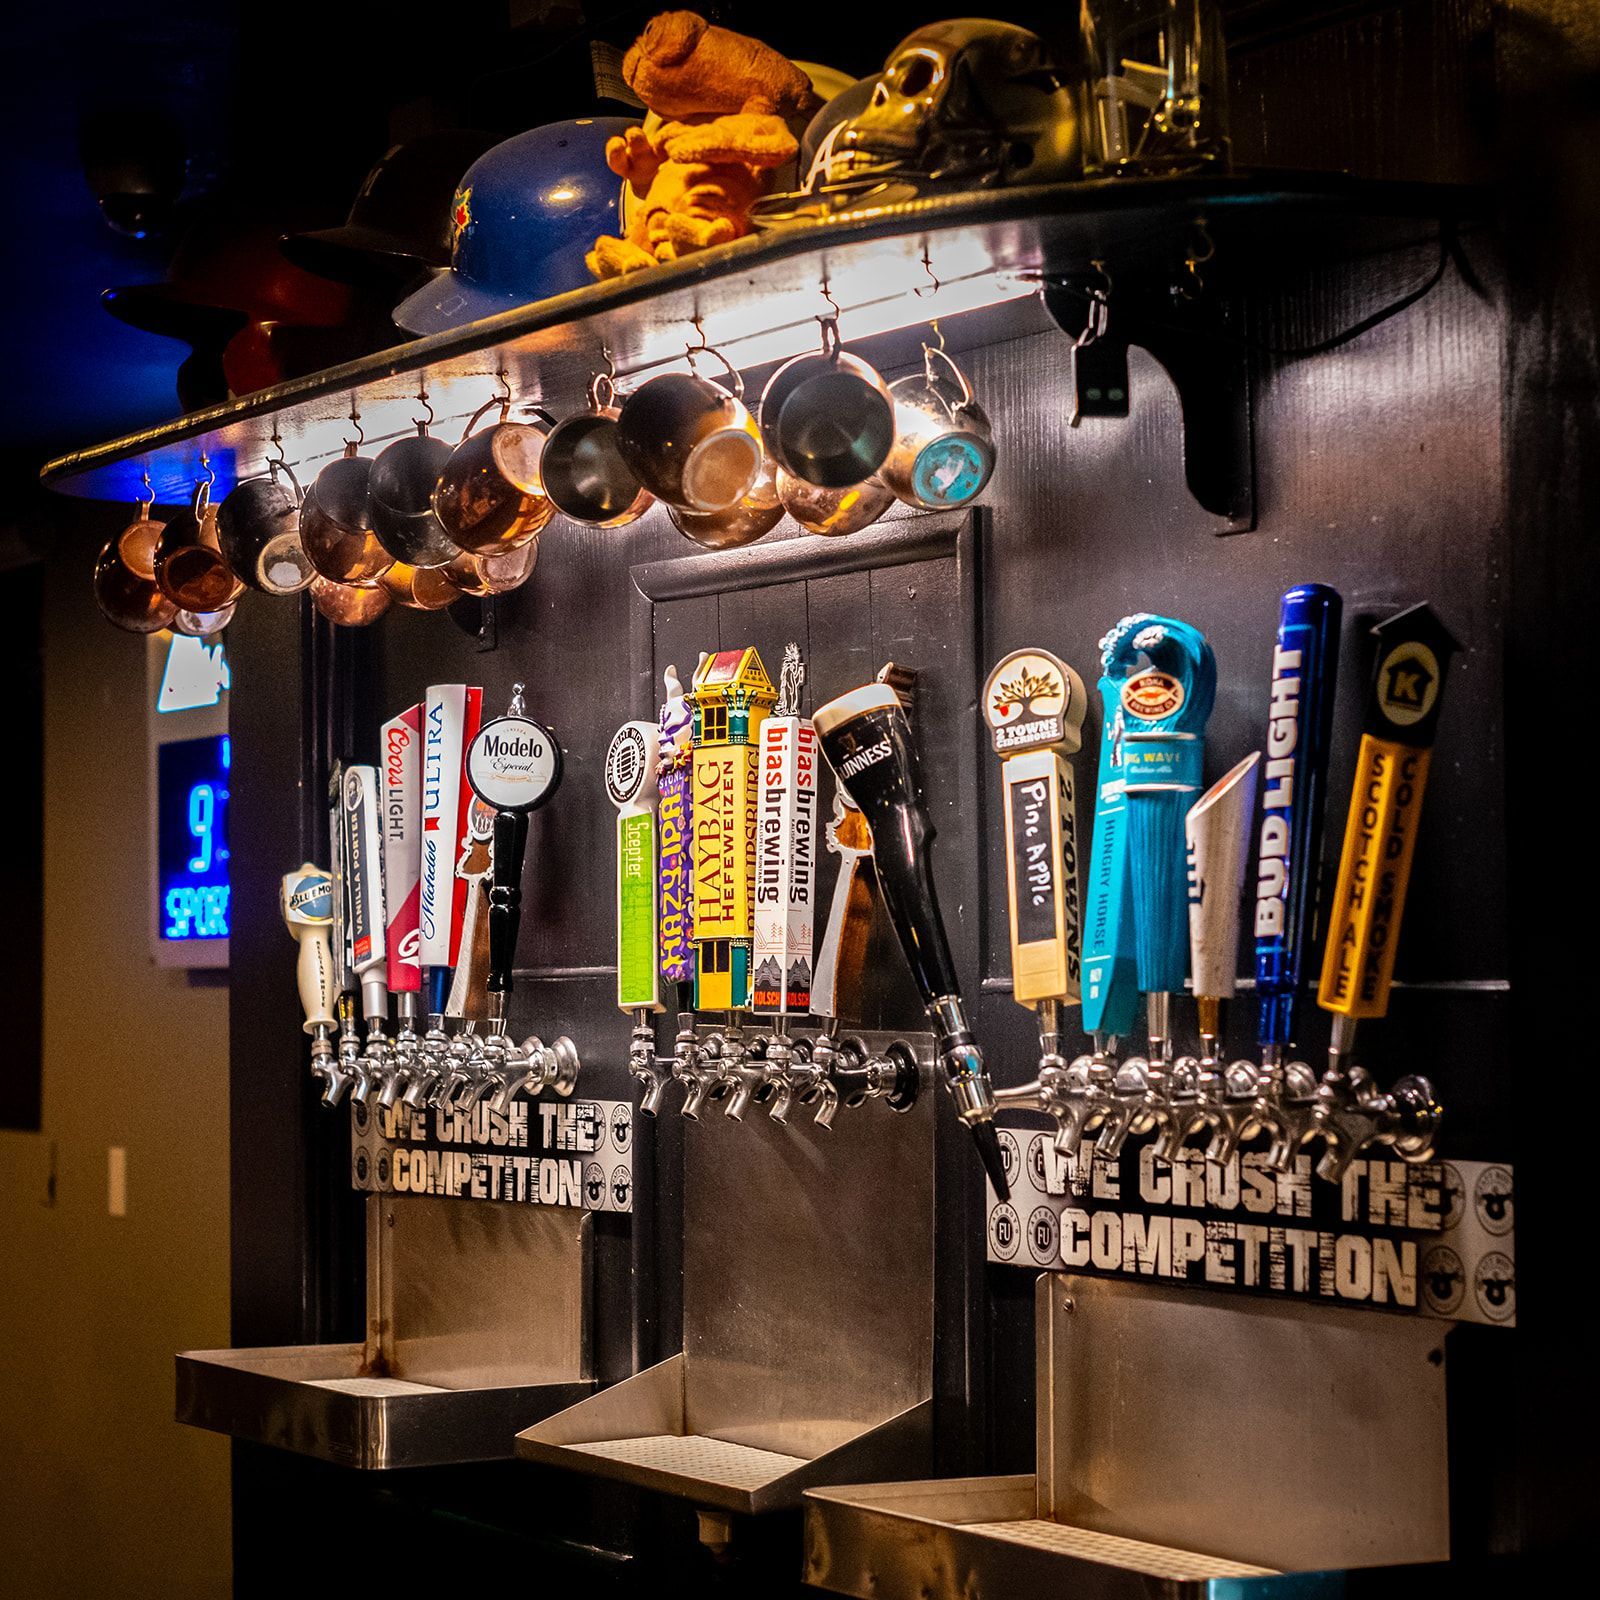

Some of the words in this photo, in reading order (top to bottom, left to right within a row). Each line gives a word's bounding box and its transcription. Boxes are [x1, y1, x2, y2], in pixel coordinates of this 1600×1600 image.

[800, 119, 849, 194] A
[1393, 670, 1420, 698] K
[387, 727, 410, 787] Coors
[425, 702, 443, 811] ULTRA
[483, 734, 543, 758] Modelo
[607, 728, 629, 784] DRAUGHT
[996, 728, 1005, 740] 2
[1006, 718, 1058, 738] TOWNS
[1263, 643, 1302, 810] LIGHT
[490, 757, 532, 774] Especial
[836, 741, 892, 780] UINNESS
[1060, 773, 1072, 801] 2
[389, 789, 404, 841] LIGHT
[661, 795, 682, 857] IPA
[1020, 781, 1047, 837] Pine
[1347, 753, 1388, 911] SCOTCH
[1385, 754, 1418, 862] COLD
[352, 813, 360, 870] PORTER
[623, 822, 649, 878] Scepter
[698, 759, 721, 925] HAYBAG
[722, 760, 734, 922] HEFEWEIZEN
[1100, 819, 1116, 889] HUNGRY
[290, 888, 316, 908] BLUE
[354, 872, 363, 935] VANILLA
[422, 838, 437, 940] Michelob
[1062, 812, 1081, 983] TOWNS
[1254, 815, 1289, 938] BUD
[662, 866, 683, 971] HAZY
[1094, 893, 1109, 949] HORSE
[1334, 930, 1357, 1001] ALE
[384, 1097, 427, 1141] WE
[435, 1100, 528, 1147] CRUSH
[539, 1101, 596, 1152] THE
[392, 1147, 583, 1208] COMPETITION
[1042, 1136, 1120, 1200] WE
[1139, 1143, 1312, 1218] CRUSH
[1342, 1158, 1443, 1231] THE
[1060, 1206, 1418, 1308] COMPETITION
